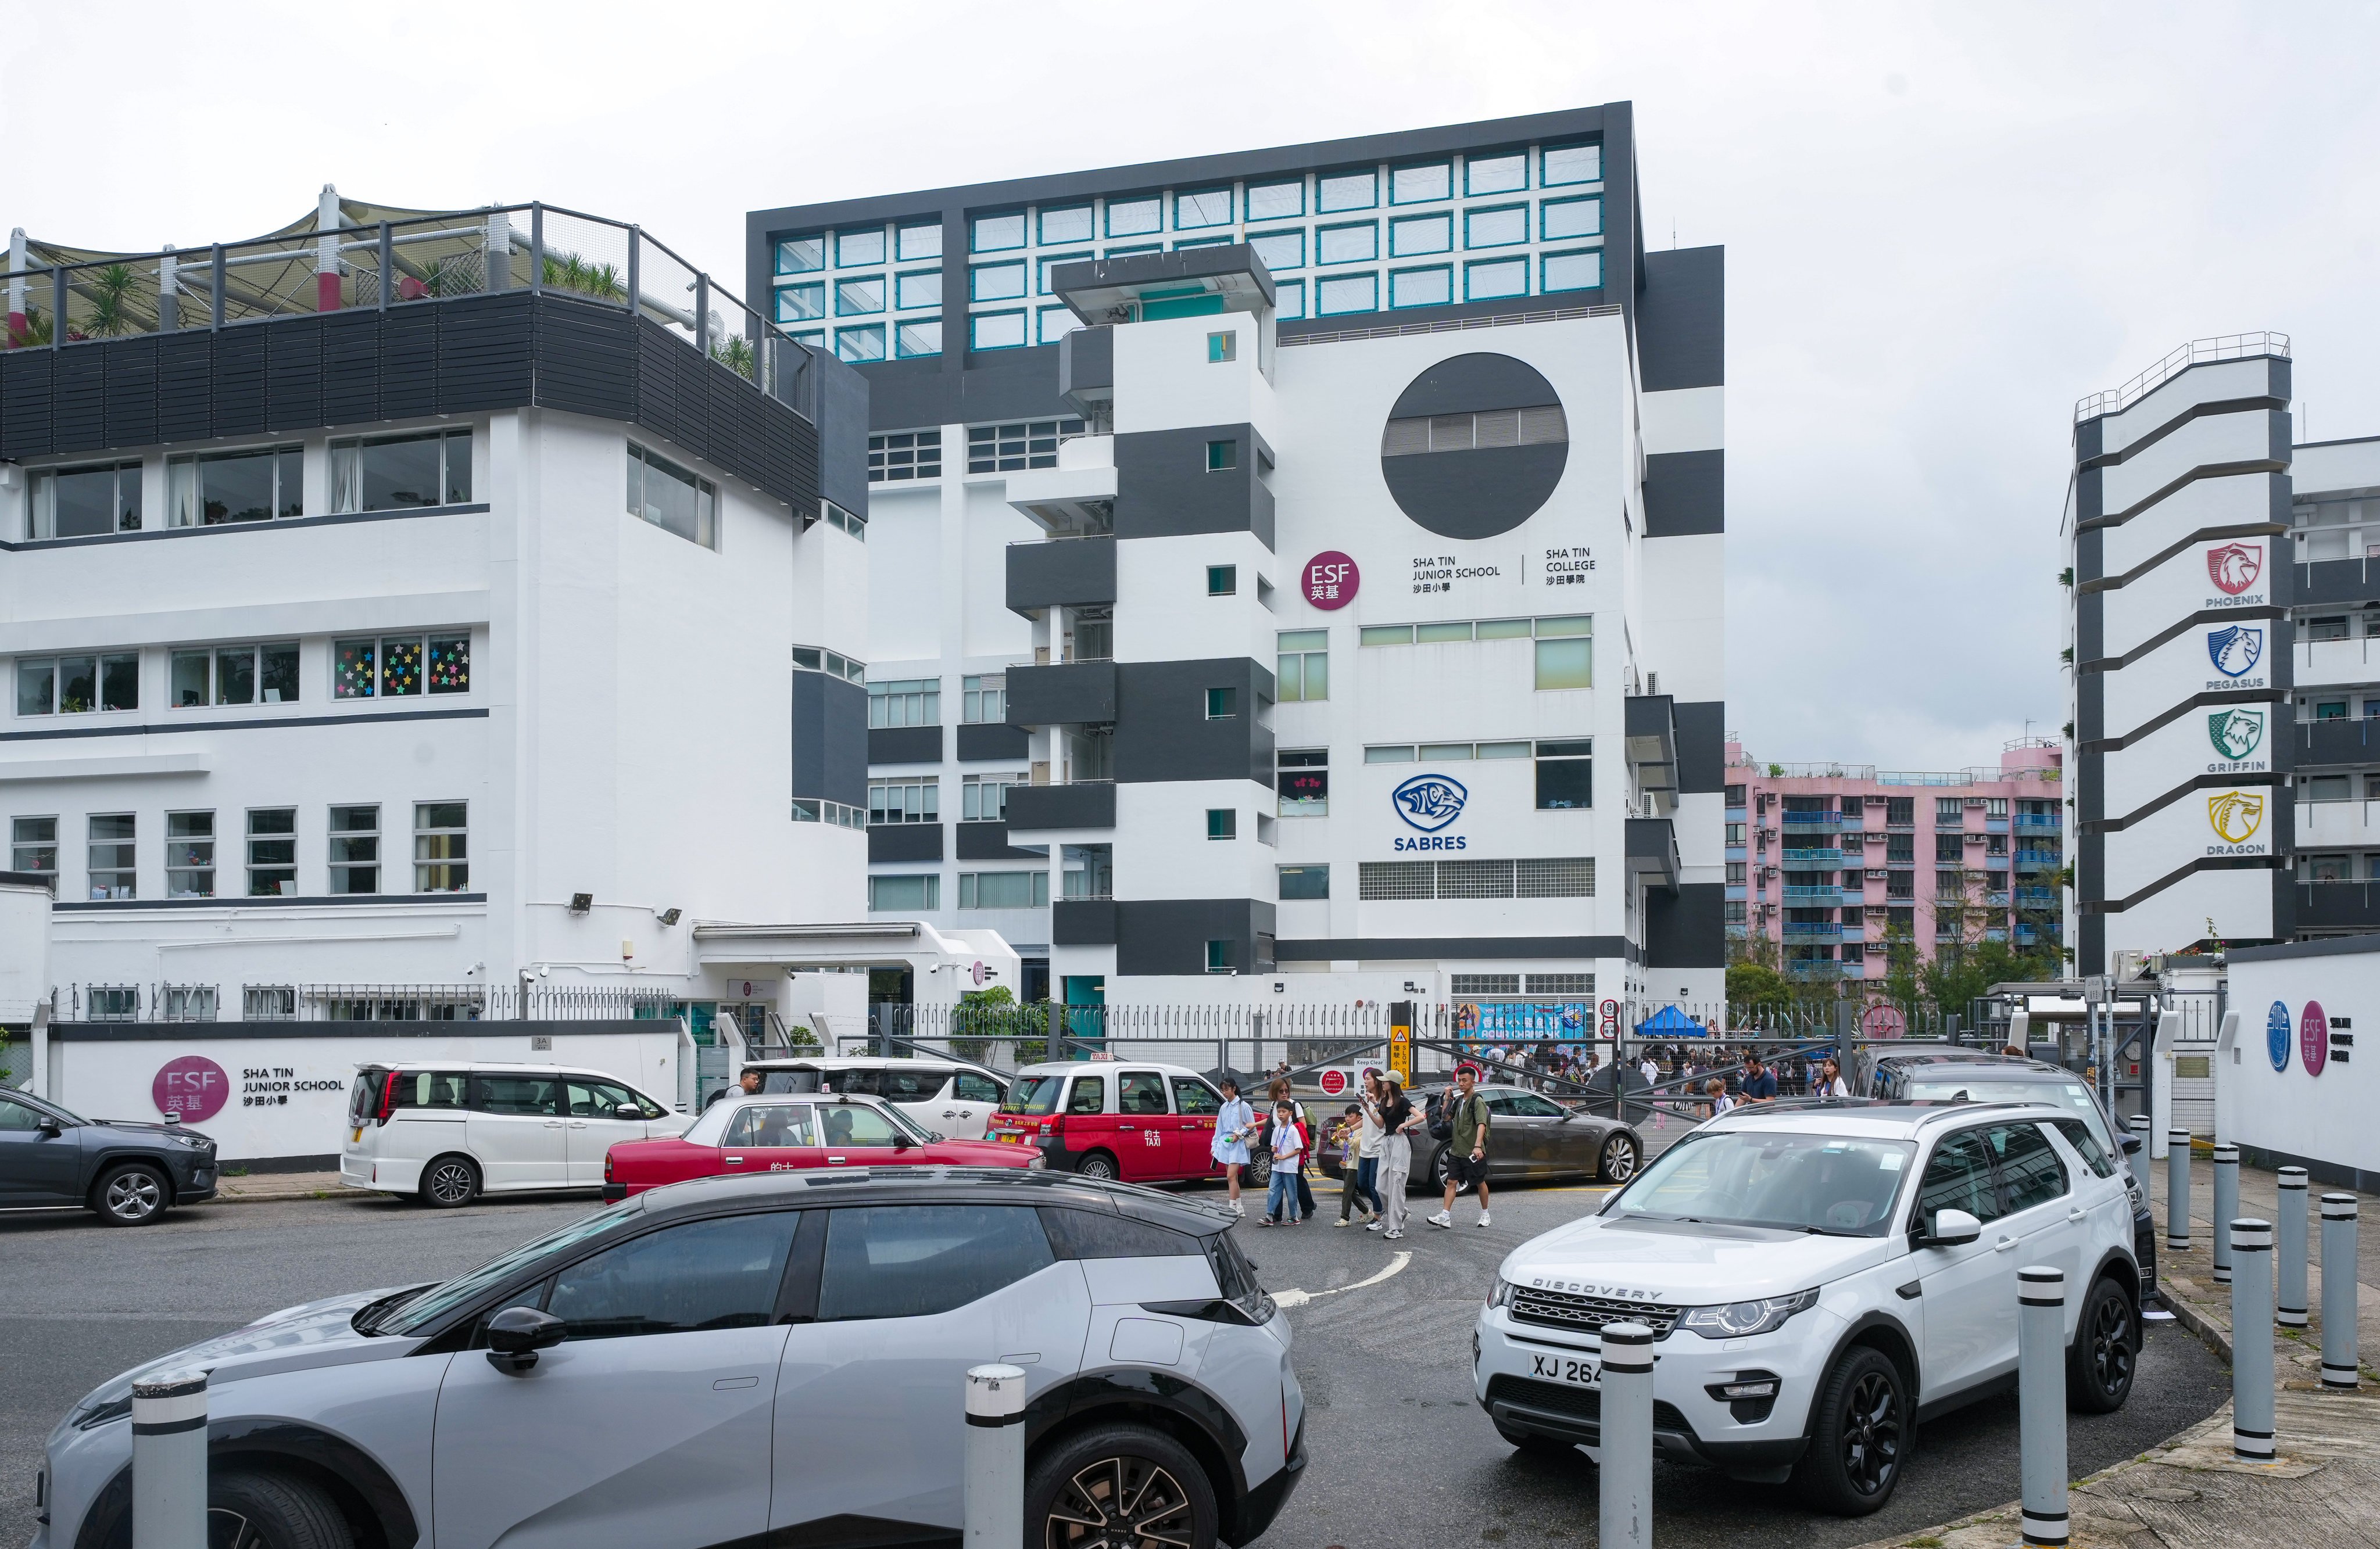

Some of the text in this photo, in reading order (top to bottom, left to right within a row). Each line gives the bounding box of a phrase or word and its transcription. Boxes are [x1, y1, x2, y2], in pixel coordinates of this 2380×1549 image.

[1546, 547, 1590, 559] SHA TIN
[1413, 556, 1455, 568] SHA TIN
[1546, 560, 1595, 572] COLLEGE
[1311, 563, 1350, 585] ESF
[1413, 566, 1501, 580] JUNIOR SCHOOL
[1546, 574, 1586, 586] 沙田學院
[1311, 584, 1339, 600] 英基
[1413, 582, 1451, 594] 沙田小學
[2206, 594, 2263, 608] PHOENIX
[2206, 677, 2264, 690] PEGASUS
[2207, 761, 2265, 773] GRIFFIN
[1394, 836, 1466, 851] SABRES
[2207, 844, 2265, 855] DRAGON
[1481, 1030, 1509, 1038] AQUA
[1547, 1030, 1560, 1038] HK
[2304, 1019, 2320, 1042] ESF
[2304, 1044, 2317, 1062] 英基
[243, 1068, 294, 1078] SHA TIN
[243, 1081, 344, 1092] JUNIOR SCHOOL
[167, 1095, 203, 1111] 英基
[243, 1095, 288, 1107] 沙田小學
[1144, 1130, 1159, 1138] 的士
[1144, 1138, 1161, 1146] TAXI
[1533, 1278, 1663, 1299] DISCOVERY
[1534, 1356, 1558, 1377] XJ
